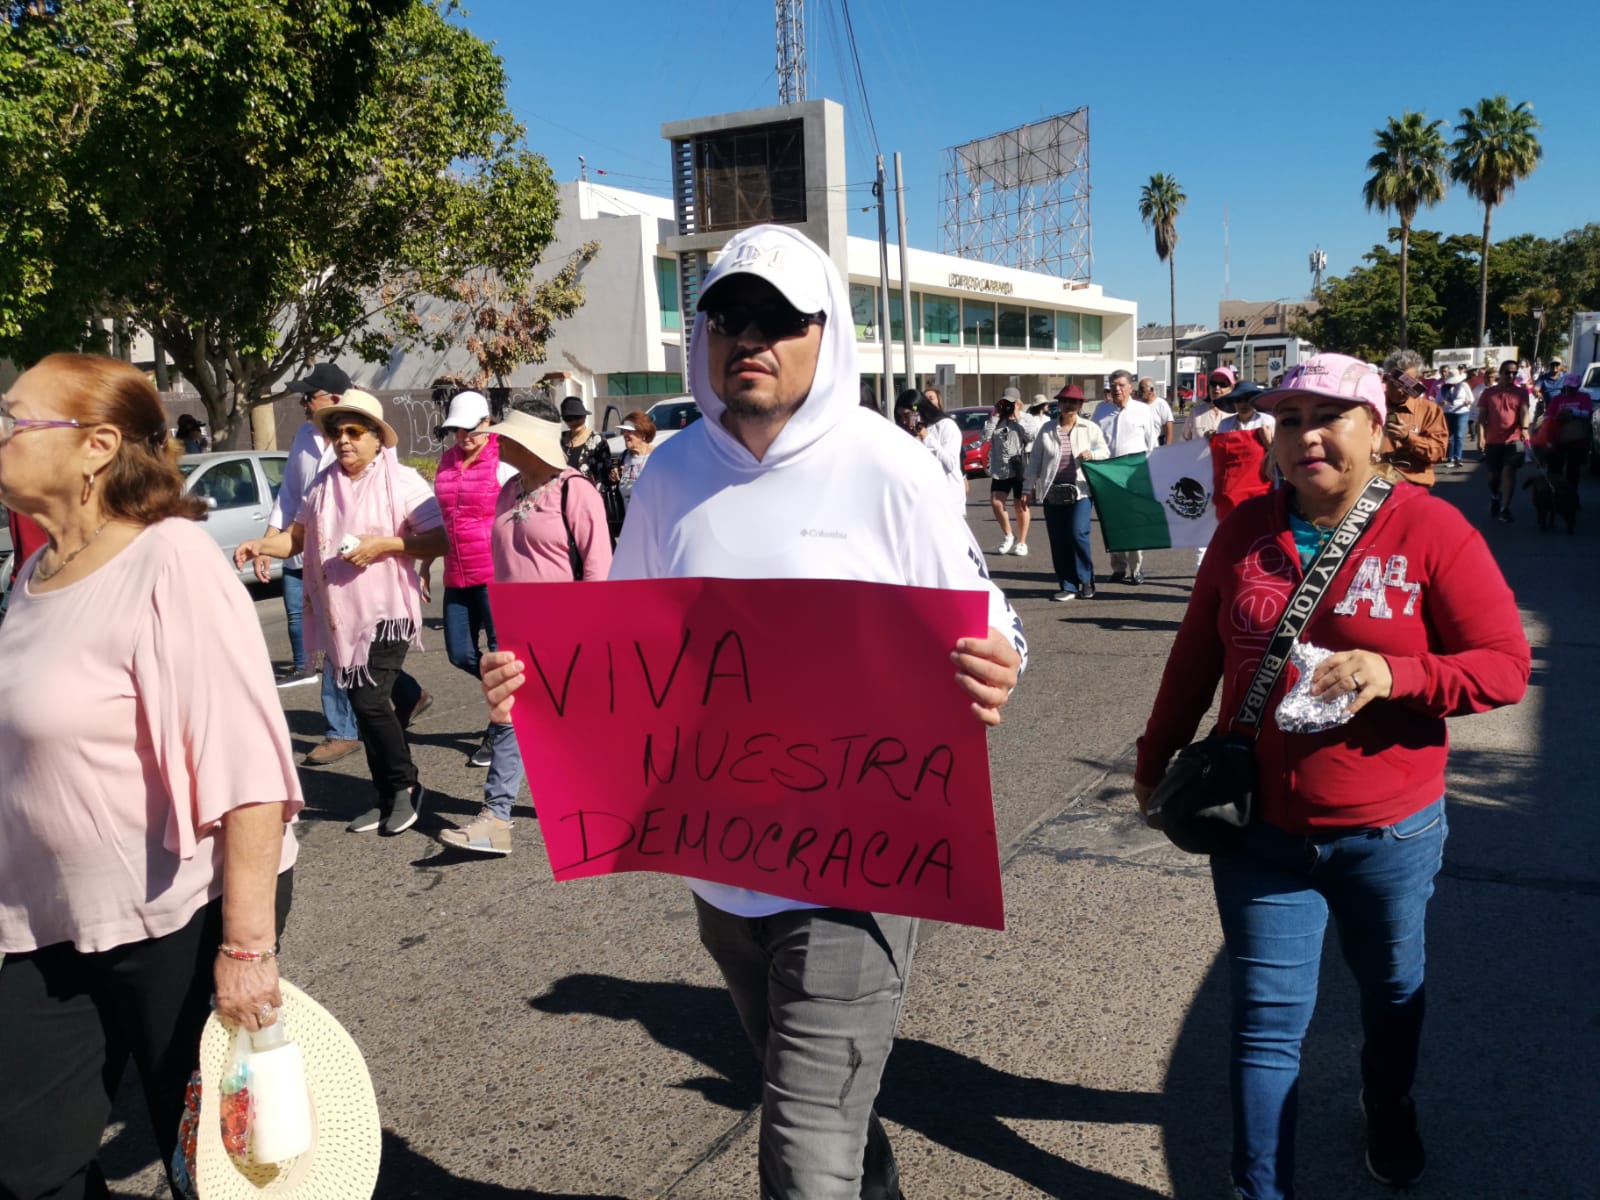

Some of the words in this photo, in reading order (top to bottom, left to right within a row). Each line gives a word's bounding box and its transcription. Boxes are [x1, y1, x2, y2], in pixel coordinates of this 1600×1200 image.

[1324, 499, 1376, 560] BIMBA
[1277, 585, 1321, 638] LOLA
[527, 629, 751, 716] VIVA
[1238, 653, 1282, 723] BIMBA
[643, 726, 955, 806] NUESTRA
[553, 808, 954, 899] DEMOCRACIA
